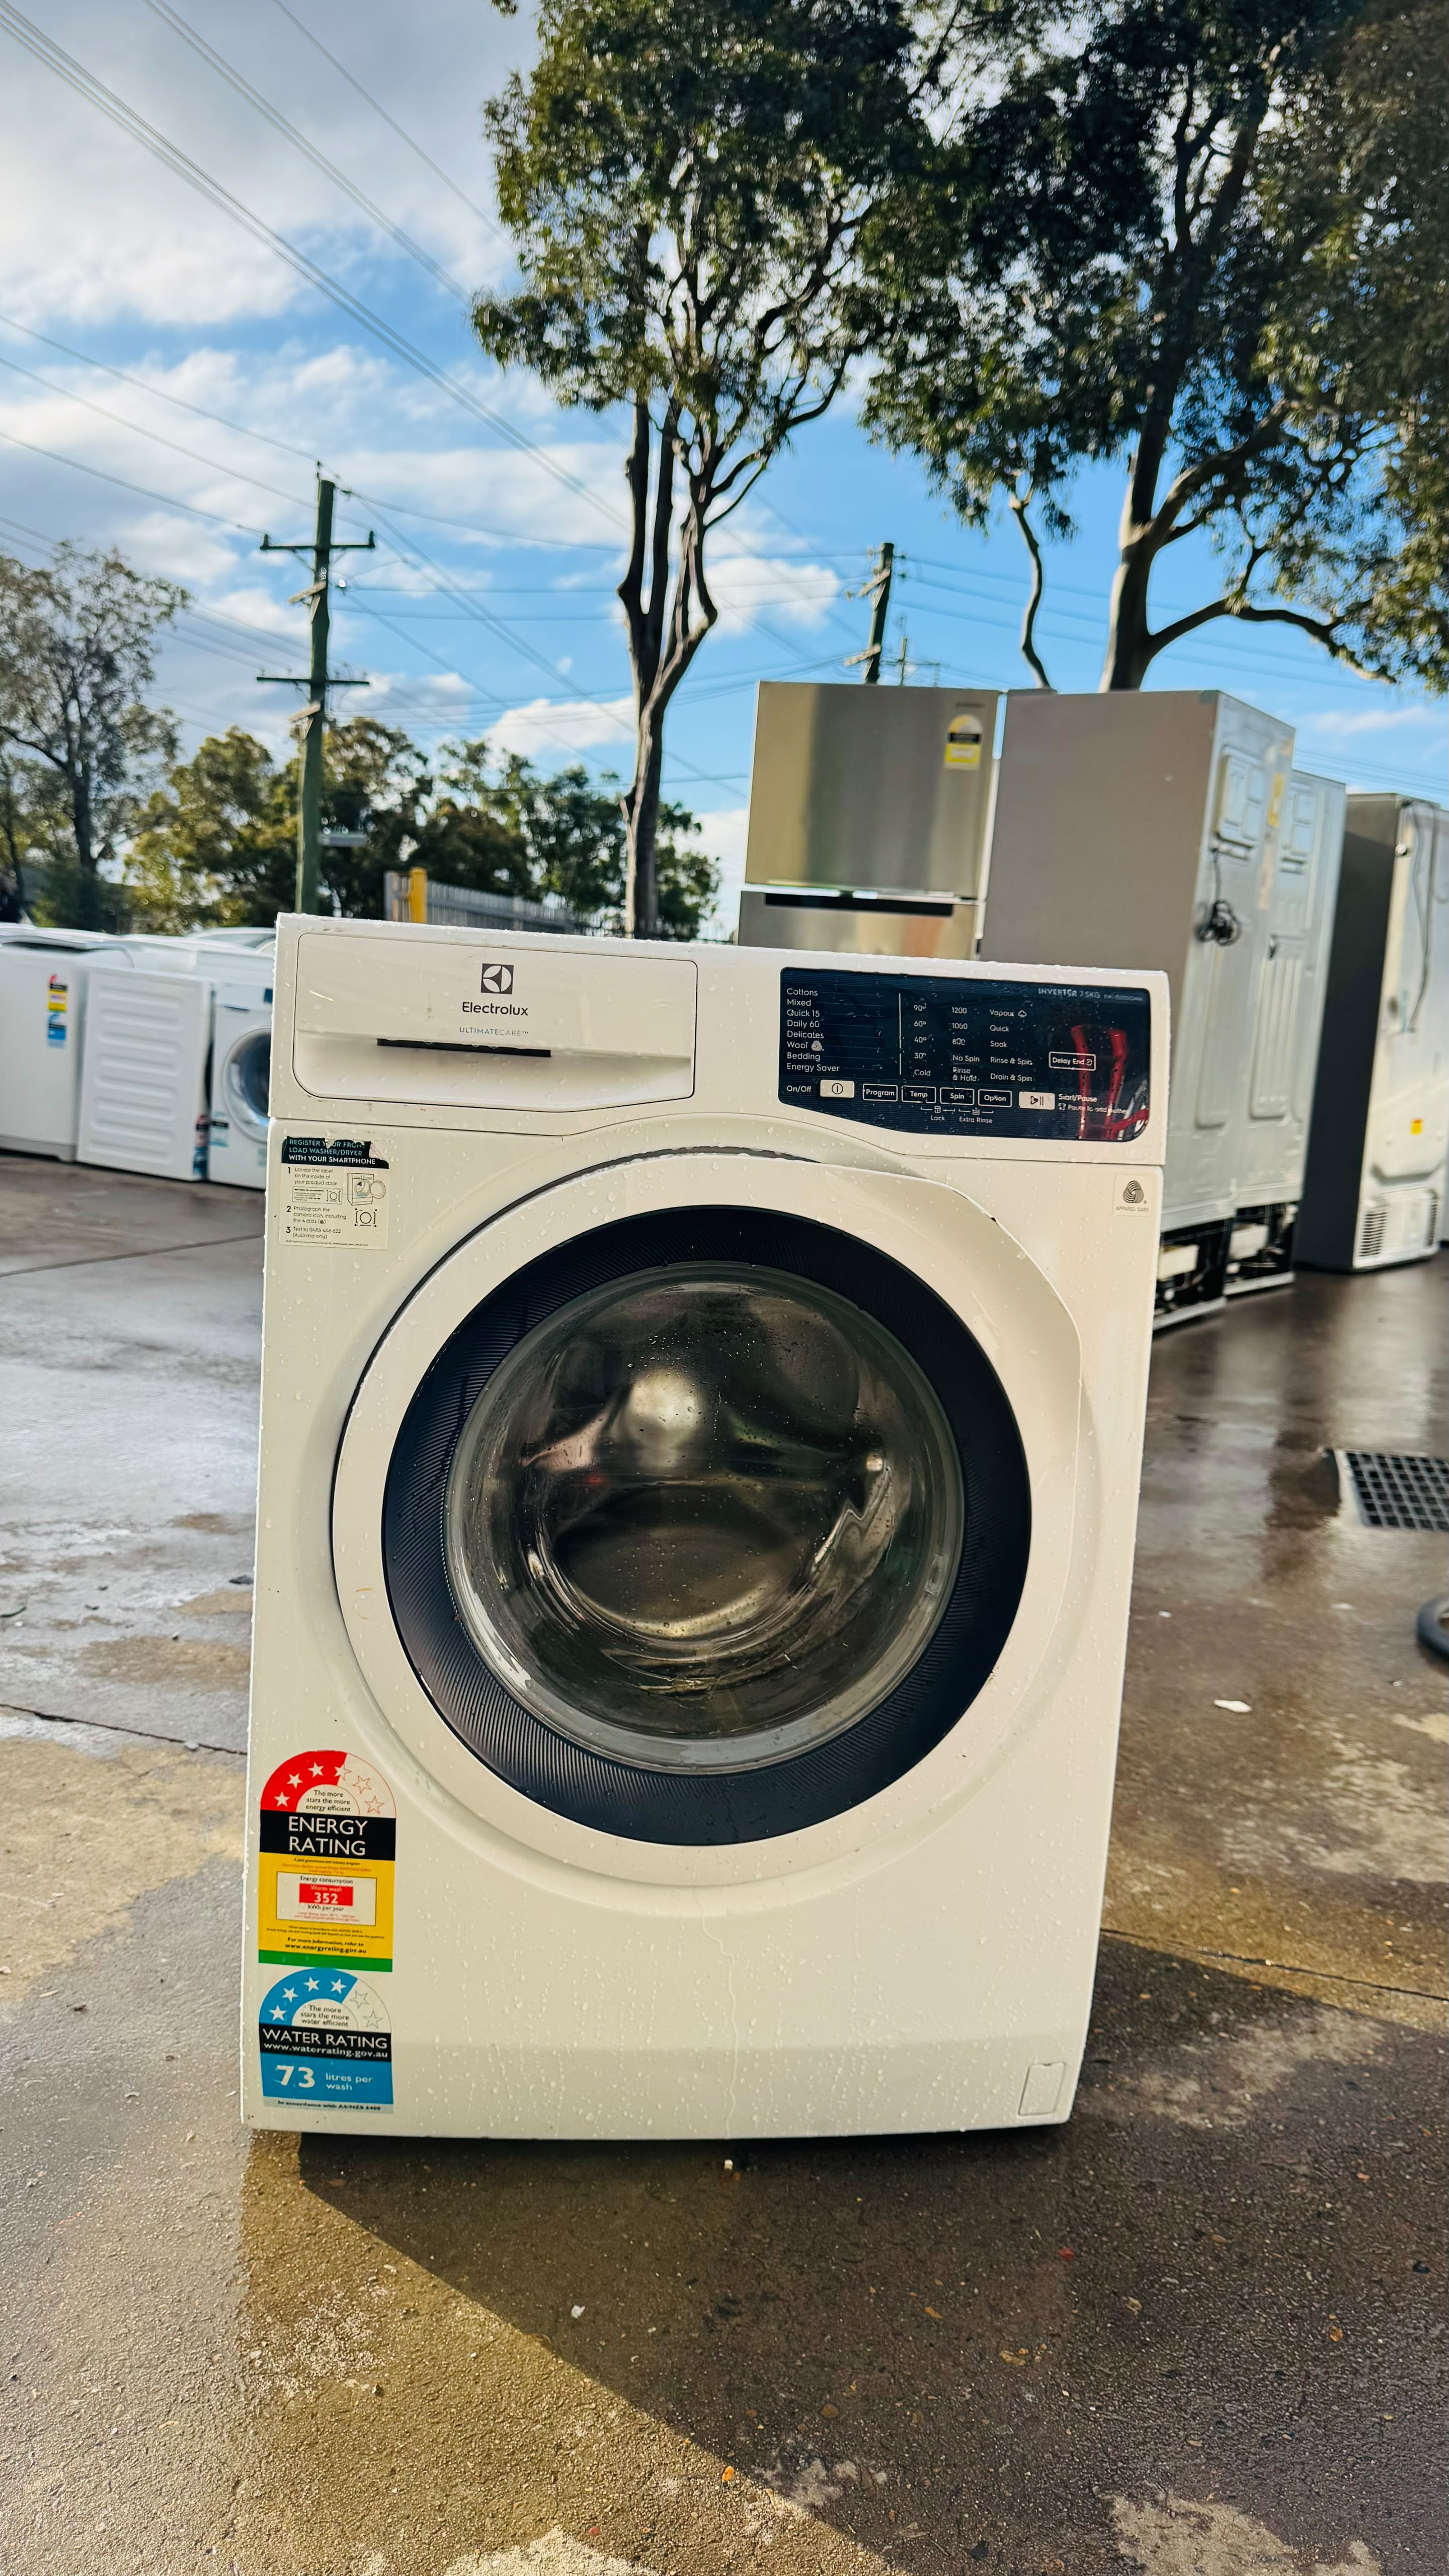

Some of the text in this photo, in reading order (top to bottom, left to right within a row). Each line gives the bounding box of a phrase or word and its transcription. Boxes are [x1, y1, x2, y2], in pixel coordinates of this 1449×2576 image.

[786, 988, 818, 996] Cottons
[1038, 988, 1077, 997] INVERTER
[462, 1002, 528, 1016] Electrolux
[787, 1019, 807, 1029] Daily
[787, 1030, 824, 1038] Delicates
[787, 1052, 820, 1062] Bedding
[1052, 1057, 1071, 1065] Delay
[787, 1063, 814, 1072] Energy
[950, 1093, 964, 1101] Spin
[1058, 1093, 1098, 1102] Start/Pause
[309, 1148, 362, 1156] WASHER/DRYER
[288, 1816, 368, 1836] ENERGY
[289, 1836, 365, 1856] RATING
[314, 1892, 339, 1904] 352
[285, 1944, 366, 1953] www.energyrating.gov.au
[262, 2028, 387, 2049] WATER RATING
[264, 2043, 388, 2058] www.waterrating.gov.au
[277, 2064, 315, 2088] 73
[326, 2073, 352, 2082] litres
